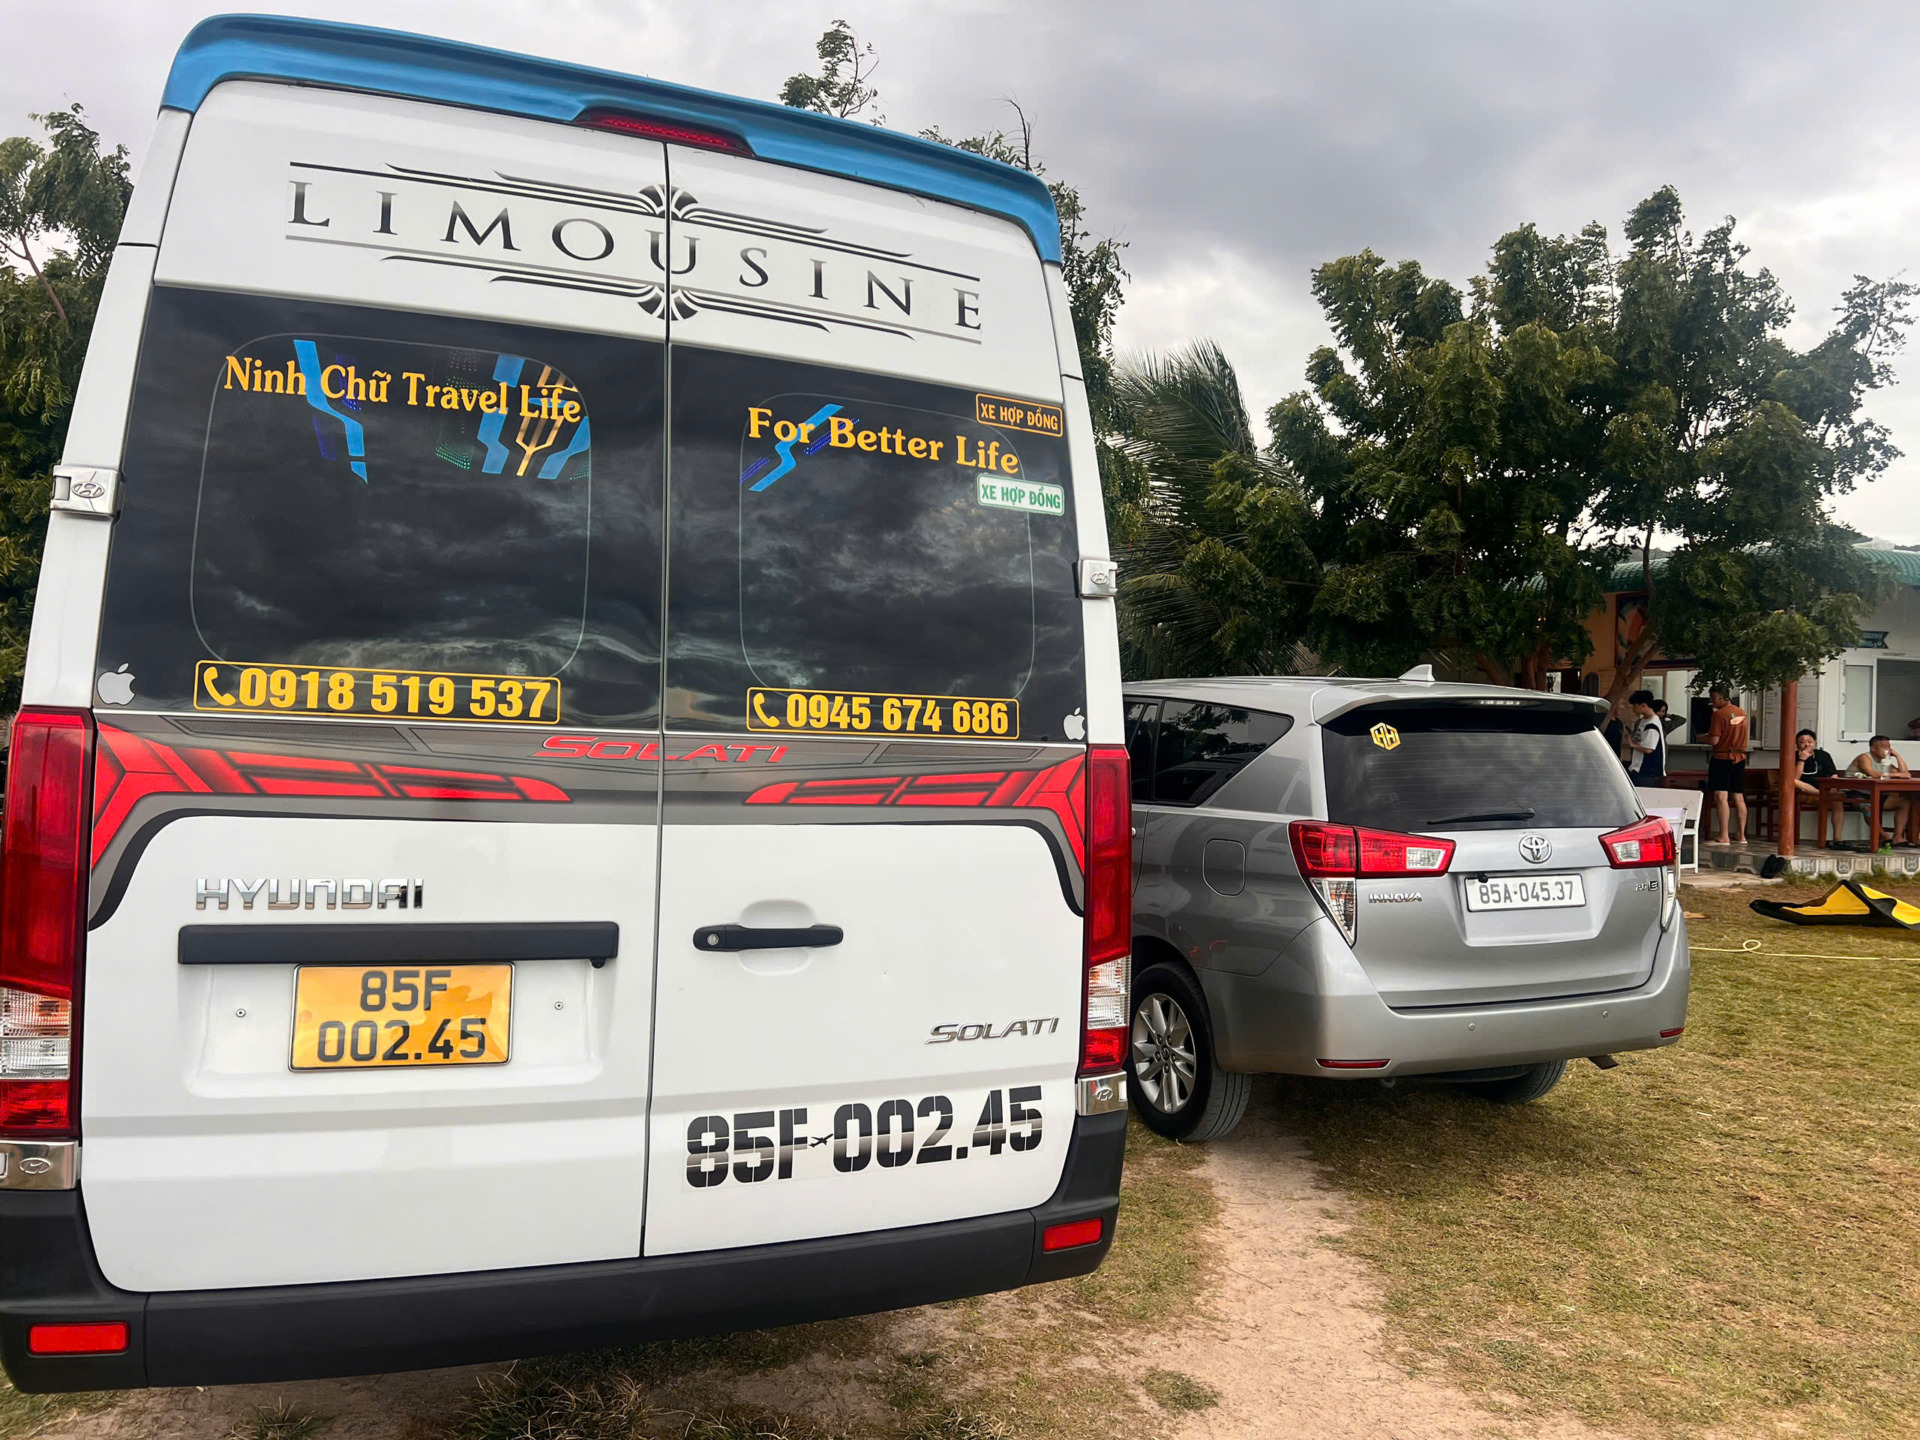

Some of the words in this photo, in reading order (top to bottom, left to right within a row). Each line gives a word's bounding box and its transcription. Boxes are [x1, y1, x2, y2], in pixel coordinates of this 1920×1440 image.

[287, 180, 982, 331] LIMOUSINE
[224, 356, 306, 395] Ninh
[320, 364, 391, 403] Chữ
[402, 372, 508, 415] Travel
[520, 384, 581, 423] Life
[980, 402, 996, 418] XE
[999, 404, 1024, 424] HỢP
[1027, 405, 1058, 431] ĐỒNG
[748, 406, 814, 444] For
[828, 416, 943, 461] Better
[956, 435, 1019, 474] Life
[981, 484, 997, 500] XE
[1001, 485, 1025, 506] HỢP
[1029, 486, 1061, 510] ĐỒNG
[239, 667, 354, 710] 0918
[370, 675, 454, 714] 519
[469, 679, 551, 718] 537
[787, 693, 871, 730] 0945
[883, 697, 942, 732] 674
[952, 700, 1008, 734] 686
[533, 735, 789, 763] SOLATI
[196, 878, 423, 910] HYUNDAI
[1369, 891, 1422, 903] INNOVA
[1479, 880, 1574, 905] 85A-045.37
[360, 970, 451, 1012] 85F
[317, 1018, 486, 1062] 002.45
[924, 1016, 1060, 1044] SOLATI
